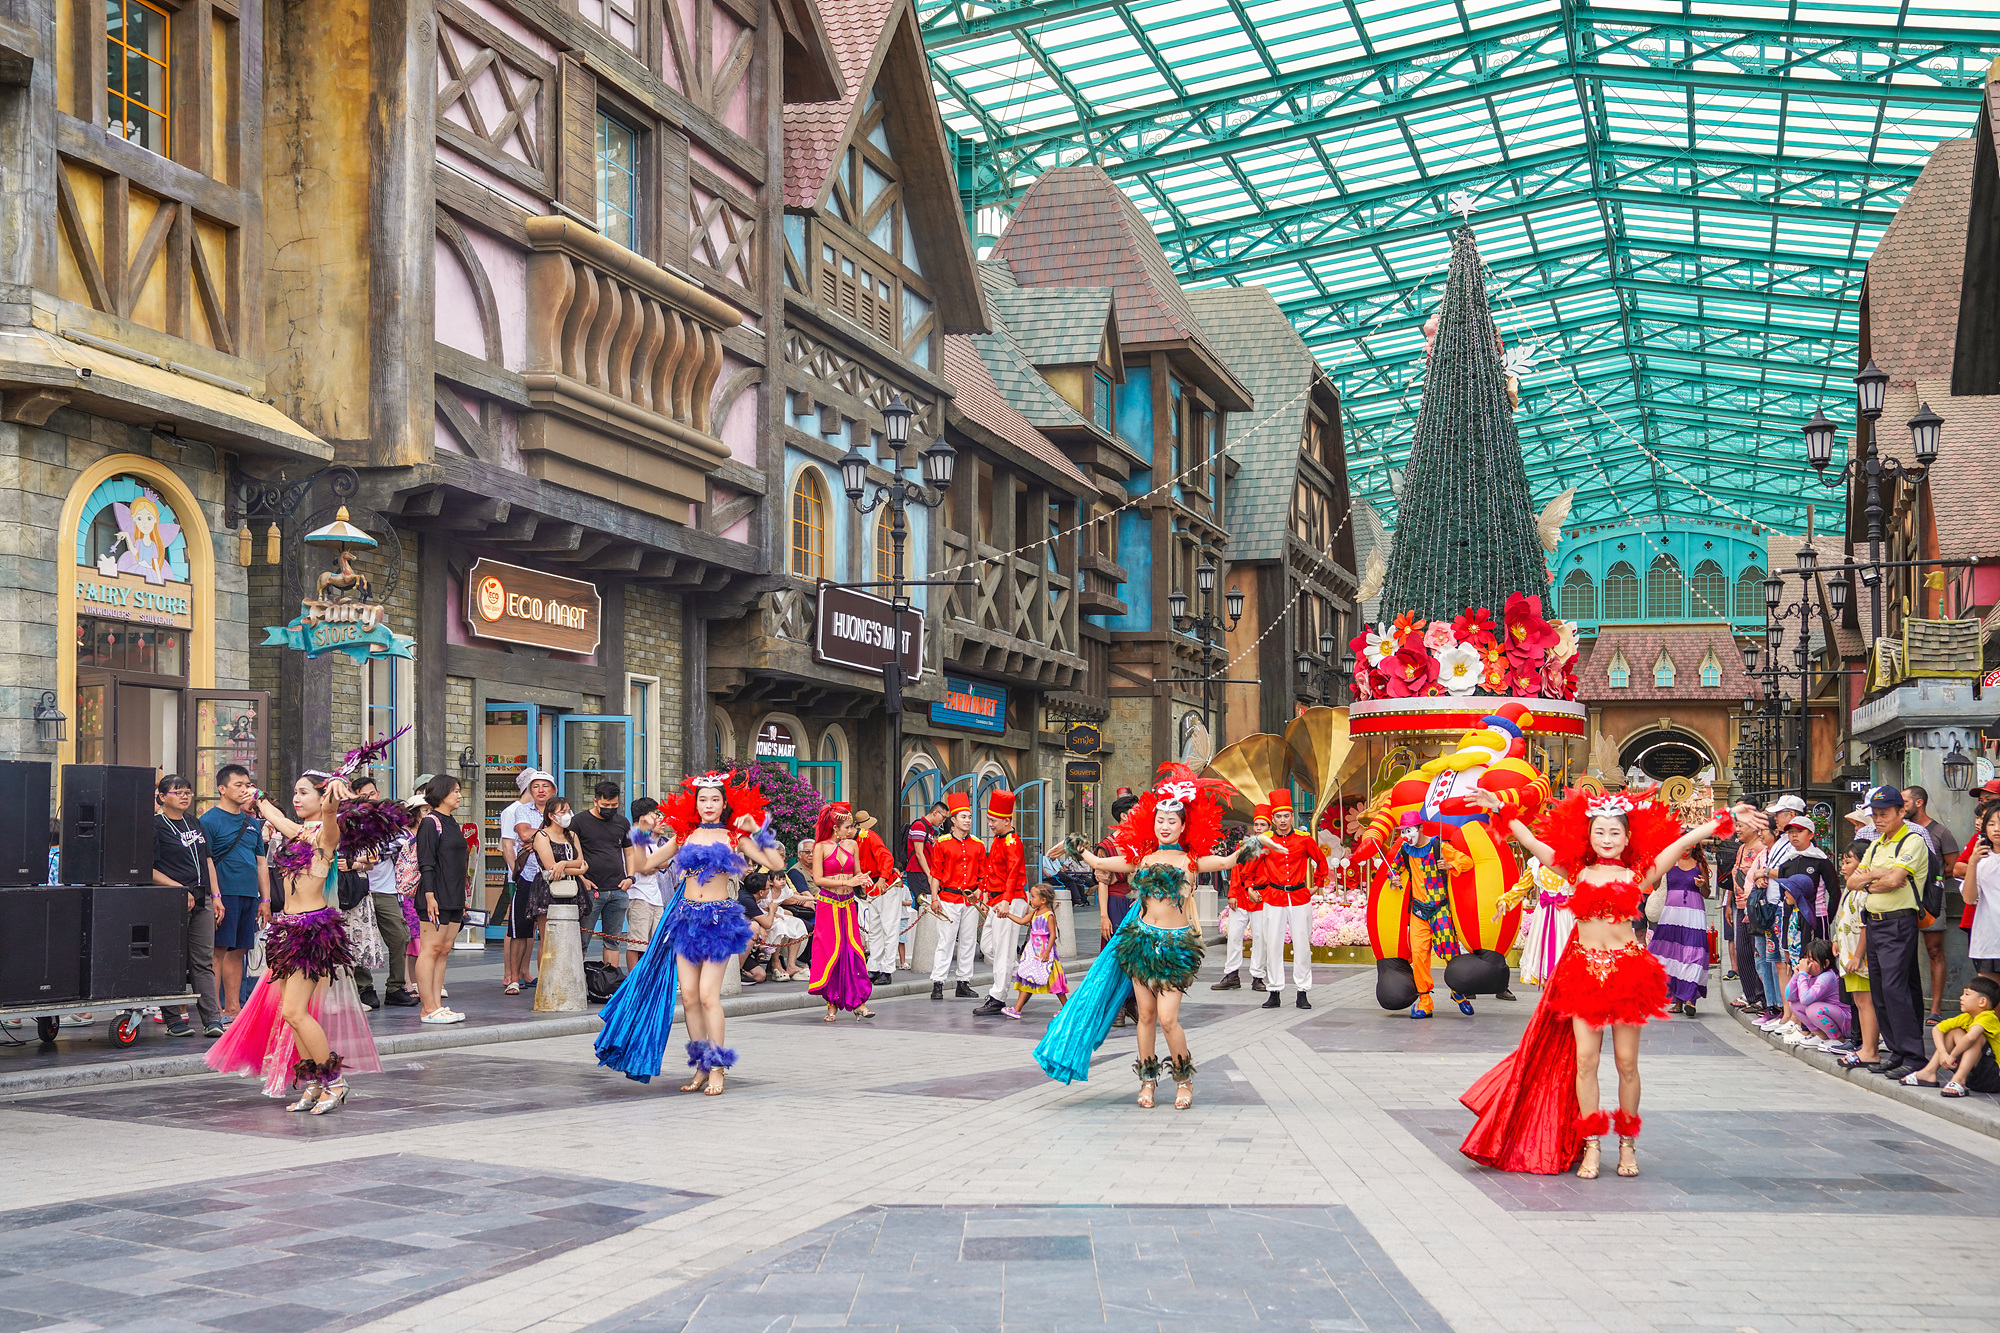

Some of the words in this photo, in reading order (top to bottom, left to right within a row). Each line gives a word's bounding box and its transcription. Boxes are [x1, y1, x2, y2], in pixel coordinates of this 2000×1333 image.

[76, 581, 132, 606] FAIRY
[133, 590, 188, 615] STORE
[84, 606, 131, 620] VINWONDERS
[139, 614, 175, 626] SOUVENIR
[506, 592, 543, 621] ECO
[544, 600, 588, 629] MART
[832, 612, 882, 646] HUONG'S
[881, 625, 911, 654] MT
[1986, 669, 2000, 685] HIG
[1072, 735, 1095, 745] Smile
[778, 744, 796, 757] MART
[1851, 781, 1873, 791] PI
